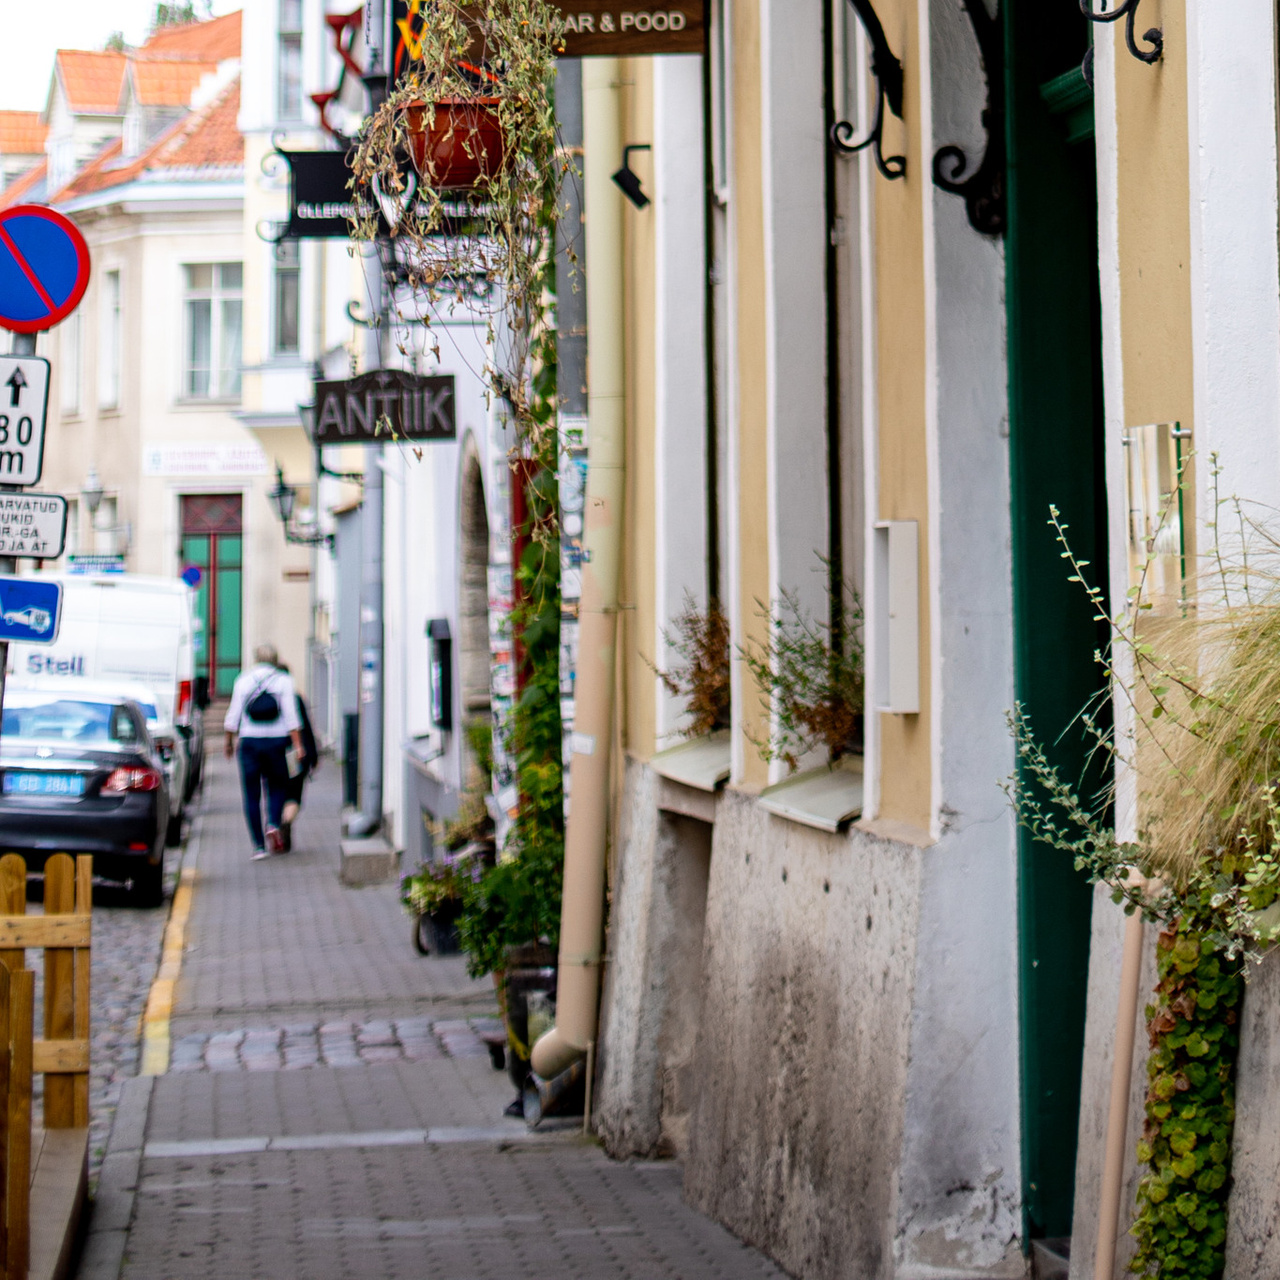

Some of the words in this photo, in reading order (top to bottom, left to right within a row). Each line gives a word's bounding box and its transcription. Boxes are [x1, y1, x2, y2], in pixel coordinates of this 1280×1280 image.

[600, 11, 616, 34] &
[620, 11, 687, 32] POOD
[317, 386, 455, 436] ANTIIK
